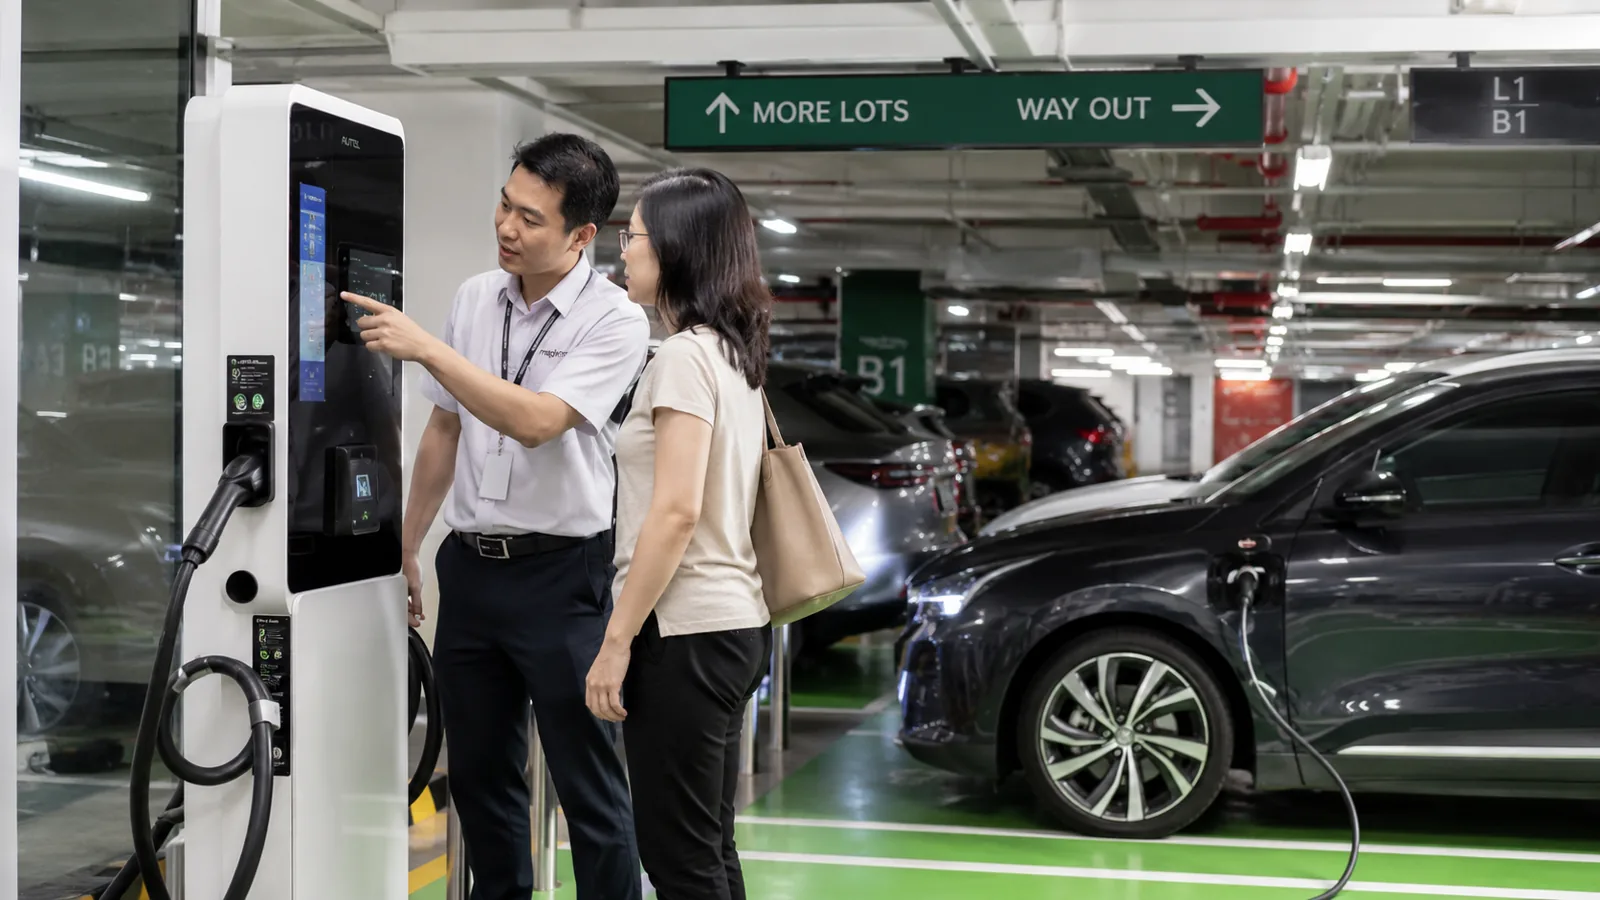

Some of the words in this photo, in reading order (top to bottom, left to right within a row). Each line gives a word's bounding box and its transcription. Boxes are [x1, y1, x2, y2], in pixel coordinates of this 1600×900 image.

[1493, 76, 1525, 101] L1
[753, 101, 831, 123] MORE
[841, 99, 910, 122] LOTS
[1017, 97, 1080, 120] WAY
[1089, 96, 1152, 120] OUT
[1493, 109, 1526, 134] B1
[858, 355, 905, 396] B1
